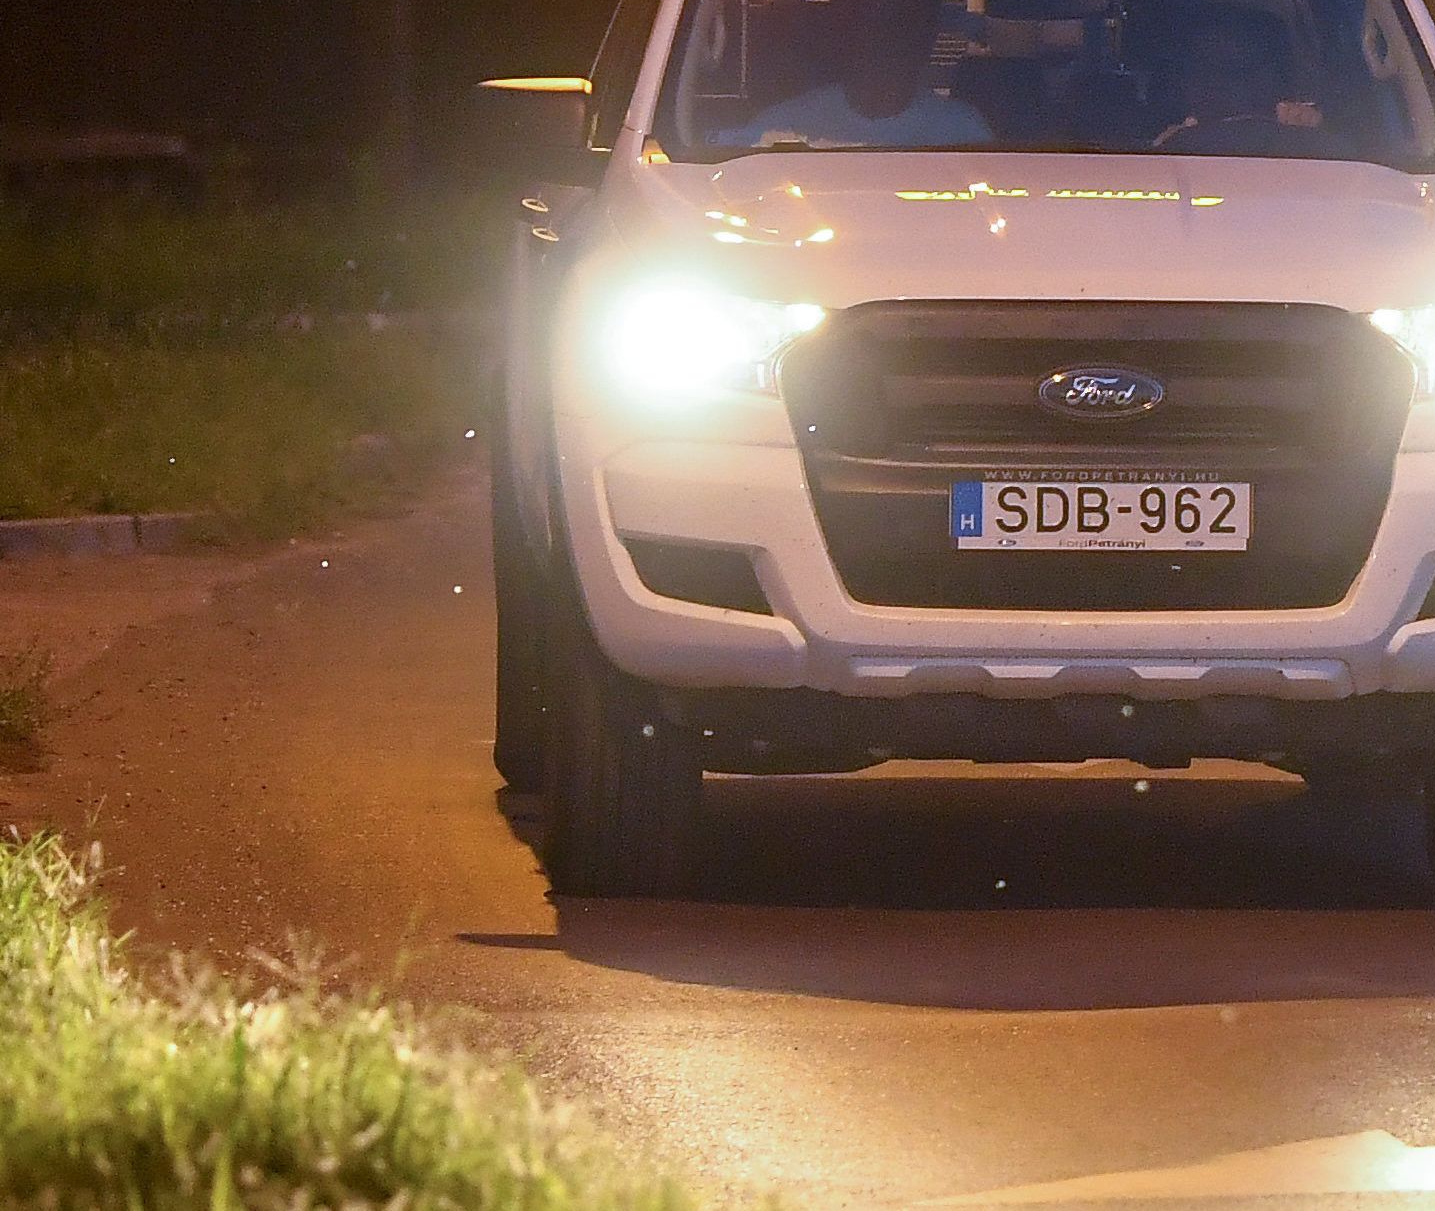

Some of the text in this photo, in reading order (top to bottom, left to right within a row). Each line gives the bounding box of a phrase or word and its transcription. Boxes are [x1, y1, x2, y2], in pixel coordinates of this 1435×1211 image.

[1065, 376, 1136, 405] Ford
[960, 514, 975, 530] H
[995, 486, 1236, 534] SDB-962
